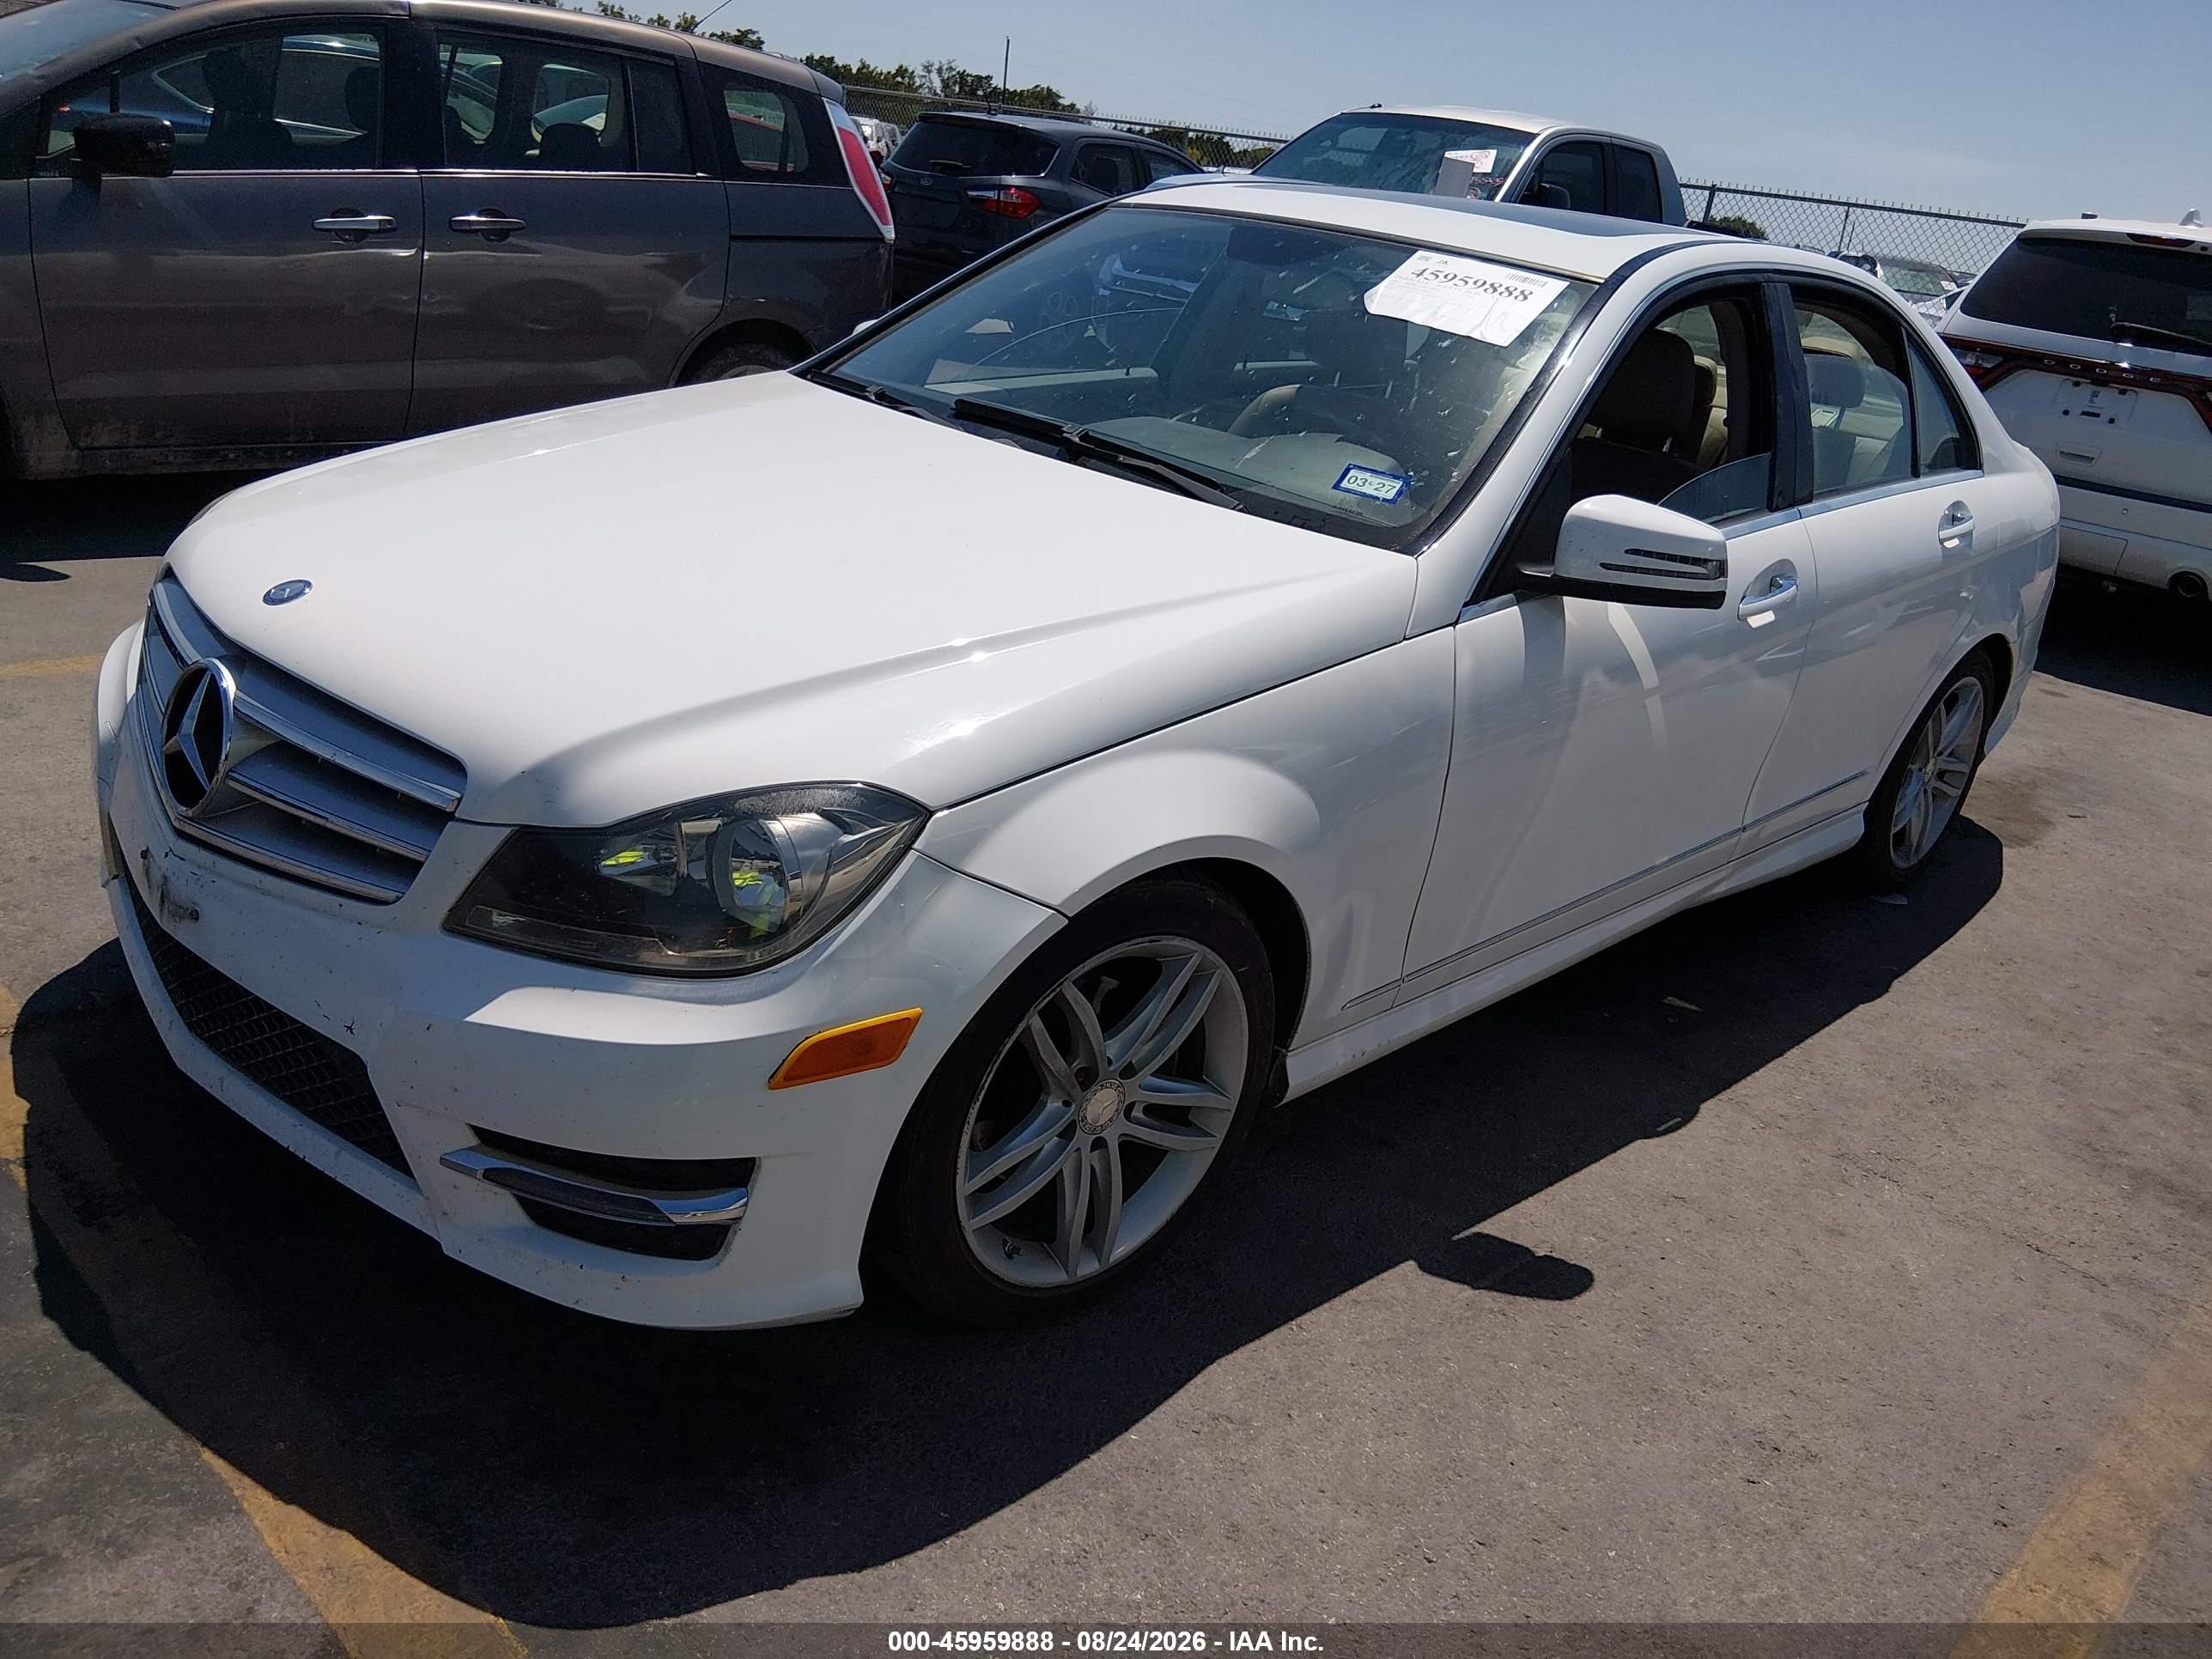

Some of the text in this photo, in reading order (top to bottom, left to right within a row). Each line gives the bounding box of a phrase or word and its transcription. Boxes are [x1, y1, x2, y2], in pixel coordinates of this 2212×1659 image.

[1411, 267, 1534, 302] 45959888
[2044, 359, 2161, 383] DODGE
[1347, 475, 1368, 488] 03
[1374, 482, 1396, 494] 27
